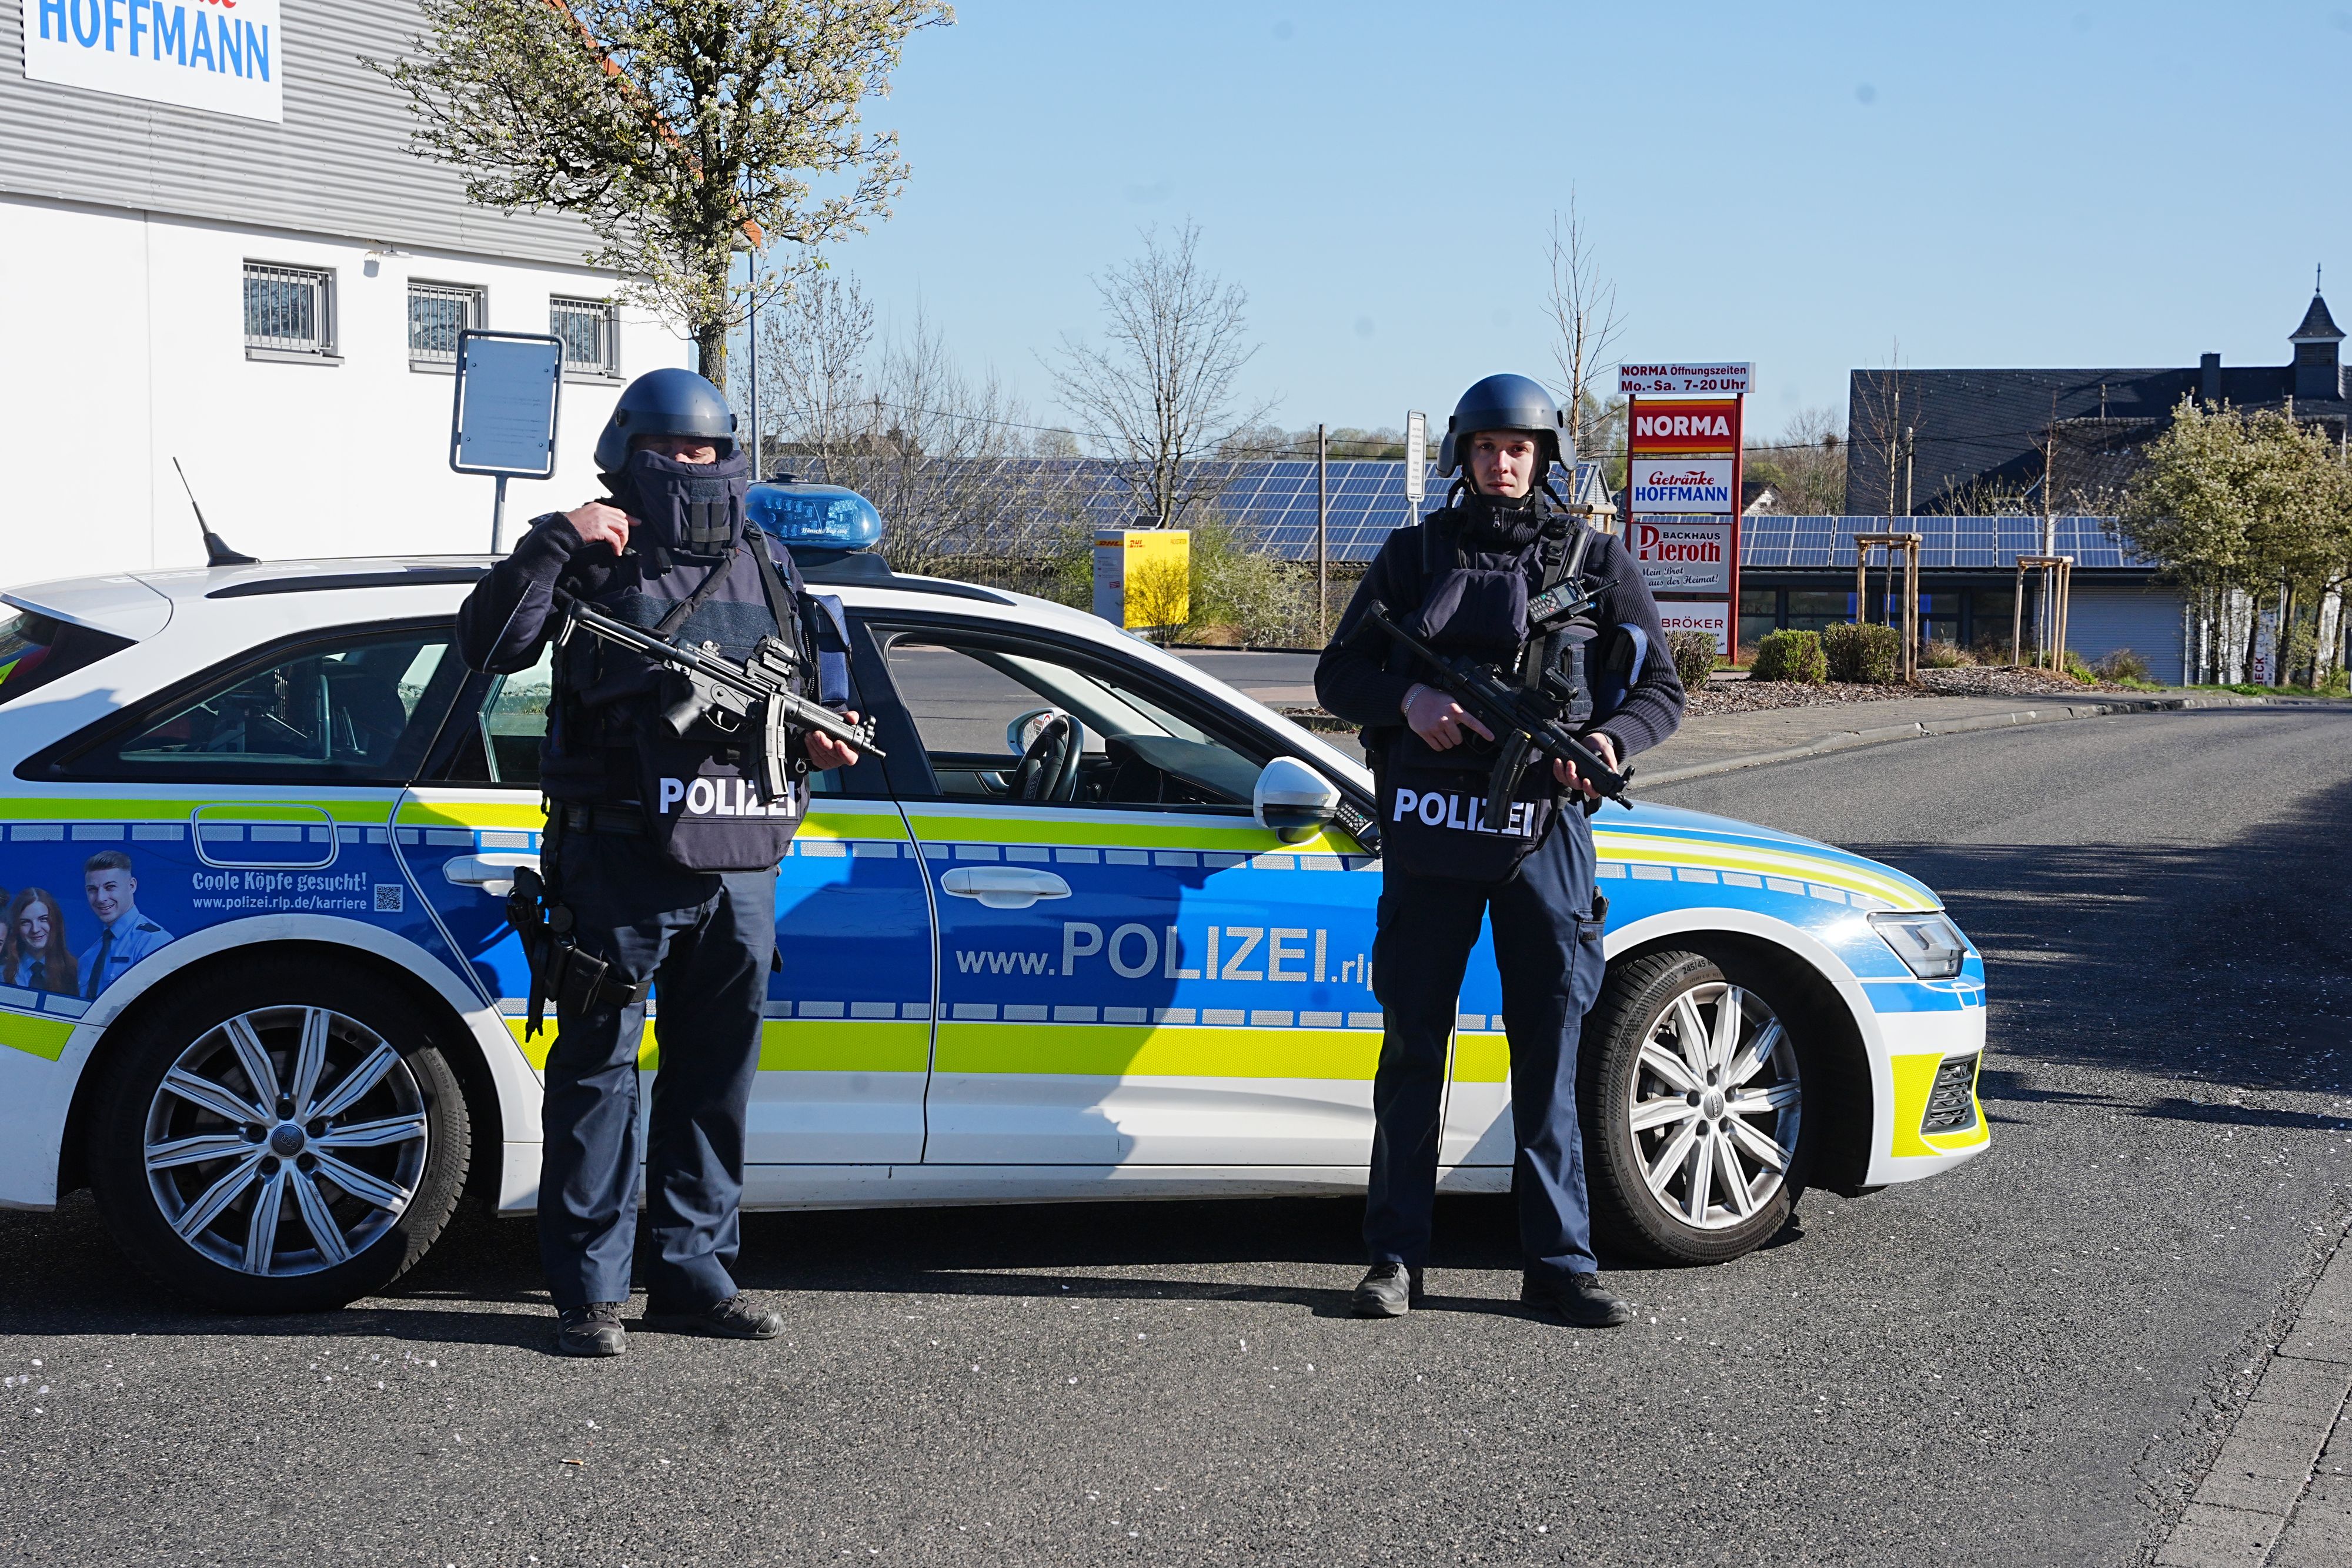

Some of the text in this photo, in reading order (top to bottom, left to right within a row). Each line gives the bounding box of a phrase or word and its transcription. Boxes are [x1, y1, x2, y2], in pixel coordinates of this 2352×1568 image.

[39, 0, 270, 82] HOFFMANN
[1621, 365, 1746, 377] NORMA Öffnungszeiten
[1720, 379, 1746, 390] Uhr
[1636, 416, 1730, 436] NORMA
[1649, 471, 1715, 485] Getränke
[1635, 487, 1728, 501] HOFFMANN
[1638, 525, 1720, 562] Pieroth
[1642, 566, 1685, 576] Mein Brot
[1667, 576, 1681, 585] der
[1683, 574, 1719, 584] Heimat!
[1661, 616, 1723, 628] BRÖKER
[193, 872, 367, 892] Coole Köpfe gesucht!
[193, 895, 367, 910] www.polizei.rlp.de/karriere
[1682, 960, 1706, 974] 245/45
